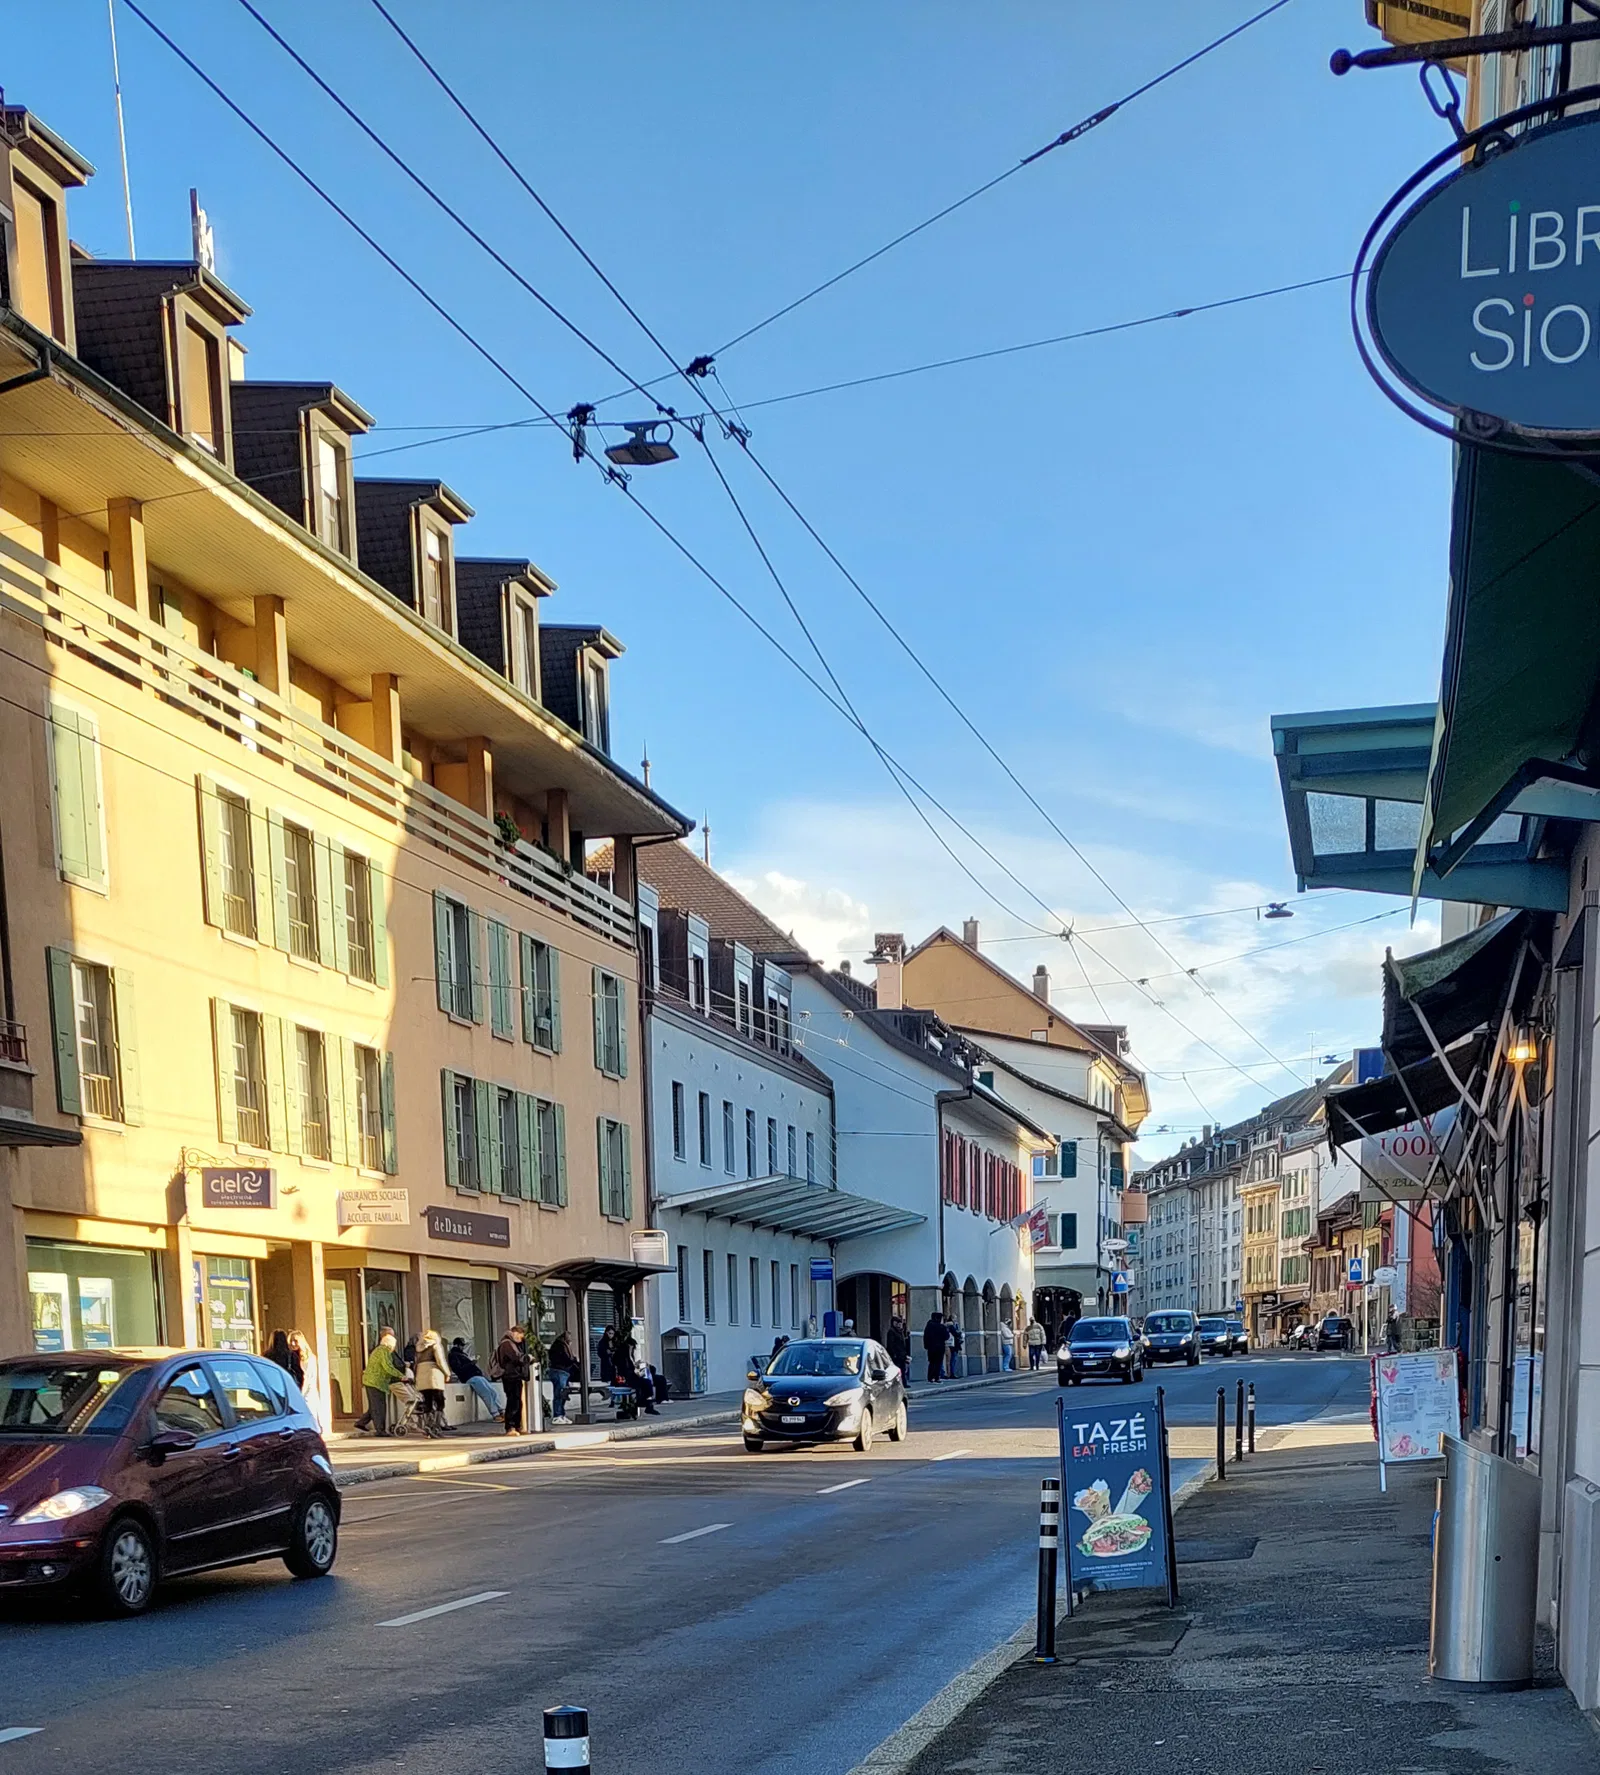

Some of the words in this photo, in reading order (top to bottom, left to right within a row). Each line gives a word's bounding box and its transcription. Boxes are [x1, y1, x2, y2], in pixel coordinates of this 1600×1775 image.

[210, 1172, 241, 1193] ciel
[341, 1190, 378, 1202] ASSURANCES
[379, 1190, 407, 1201] SOCIALES
[346, 1212, 373, 1223] ACCUEIL
[374, 1211, 404, 1223] FAMILIAL
[1072, 1412, 1147, 1445] TAZÉ
[1072, 1444, 1098, 1458] EAT
[1102, 1439, 1147, 1455] FRESH
